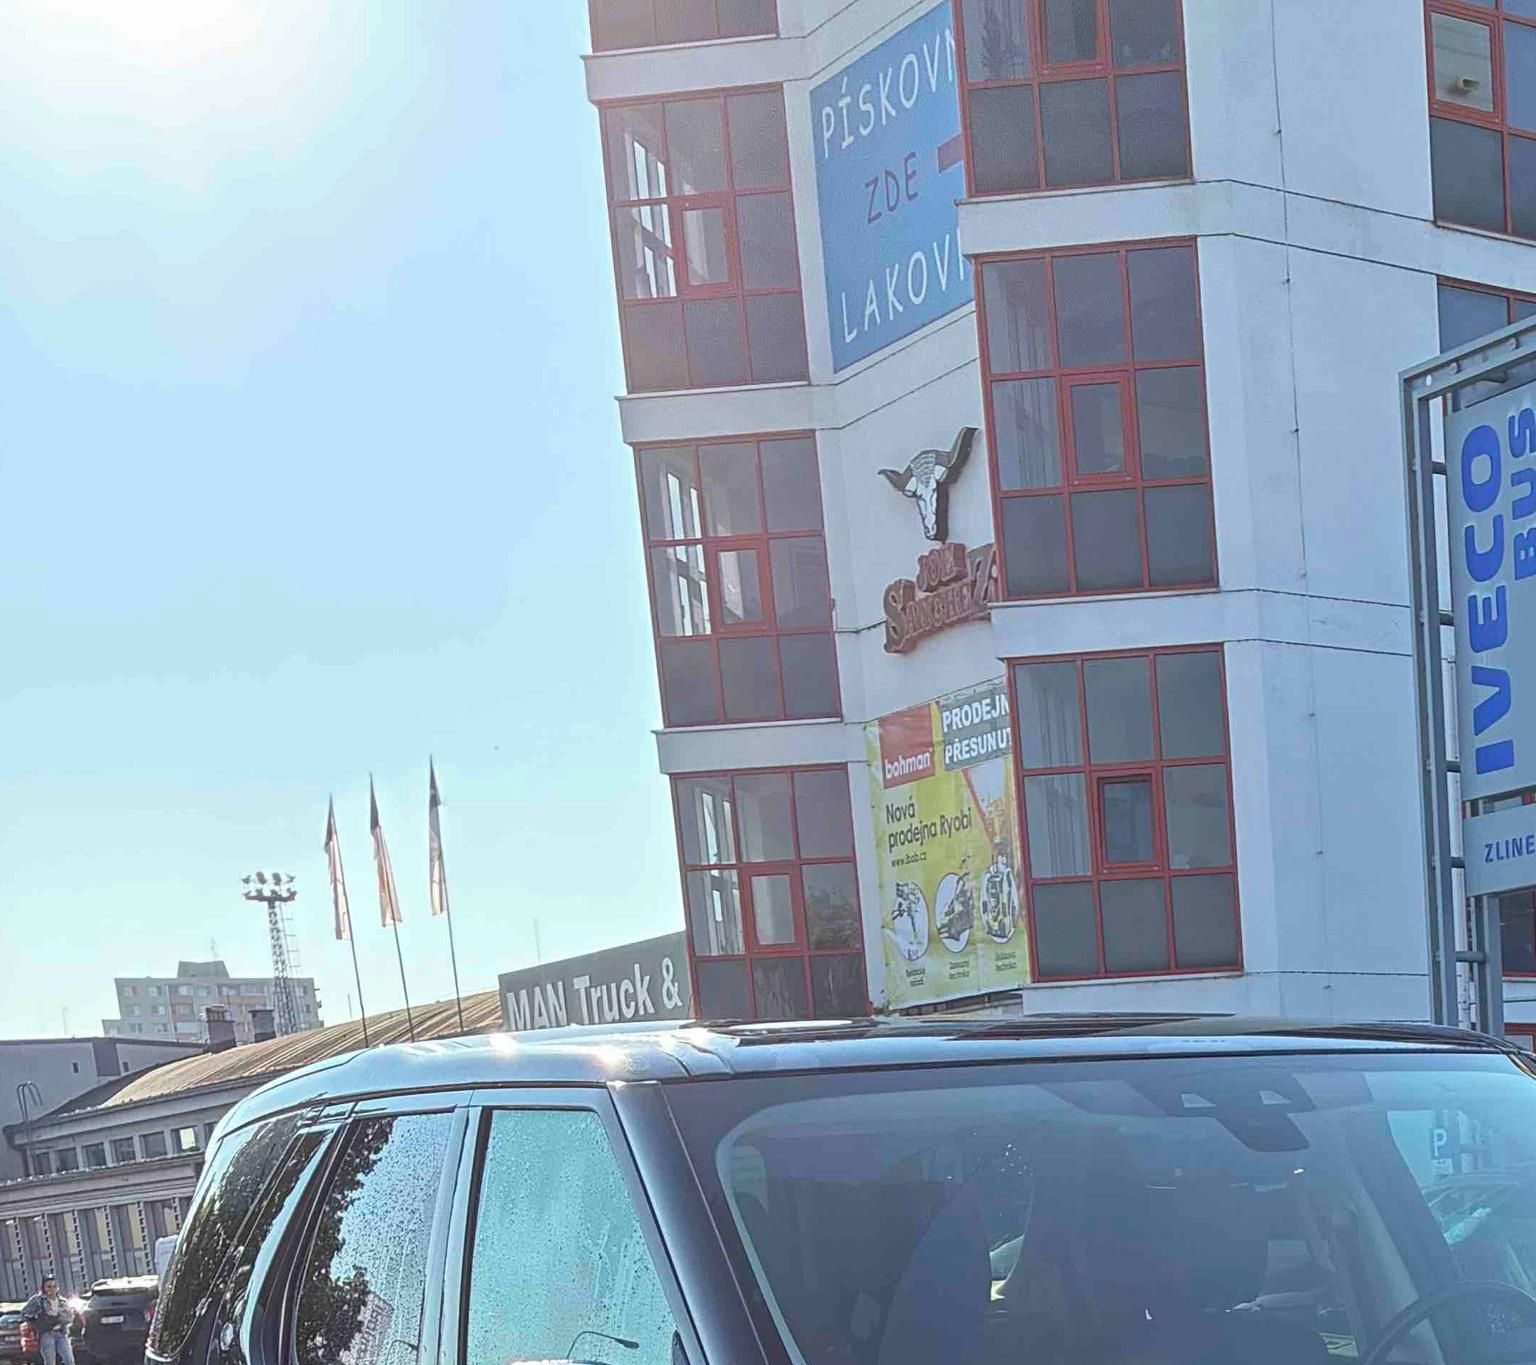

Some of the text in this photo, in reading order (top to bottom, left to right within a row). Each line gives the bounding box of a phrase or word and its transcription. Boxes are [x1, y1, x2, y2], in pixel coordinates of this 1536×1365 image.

[864, 151, 919, 224] ZDE
[1461, 424, 1514, 775] IVECO
[885, 750, 932, 779] bohman
[886, 795, 915, 824] Nová
[888, 807, 972, 853] prodejna Ryobi
[506, 956, 683, 1031] MAN Truck &
[1433, 1129, 1447, 1157] P
